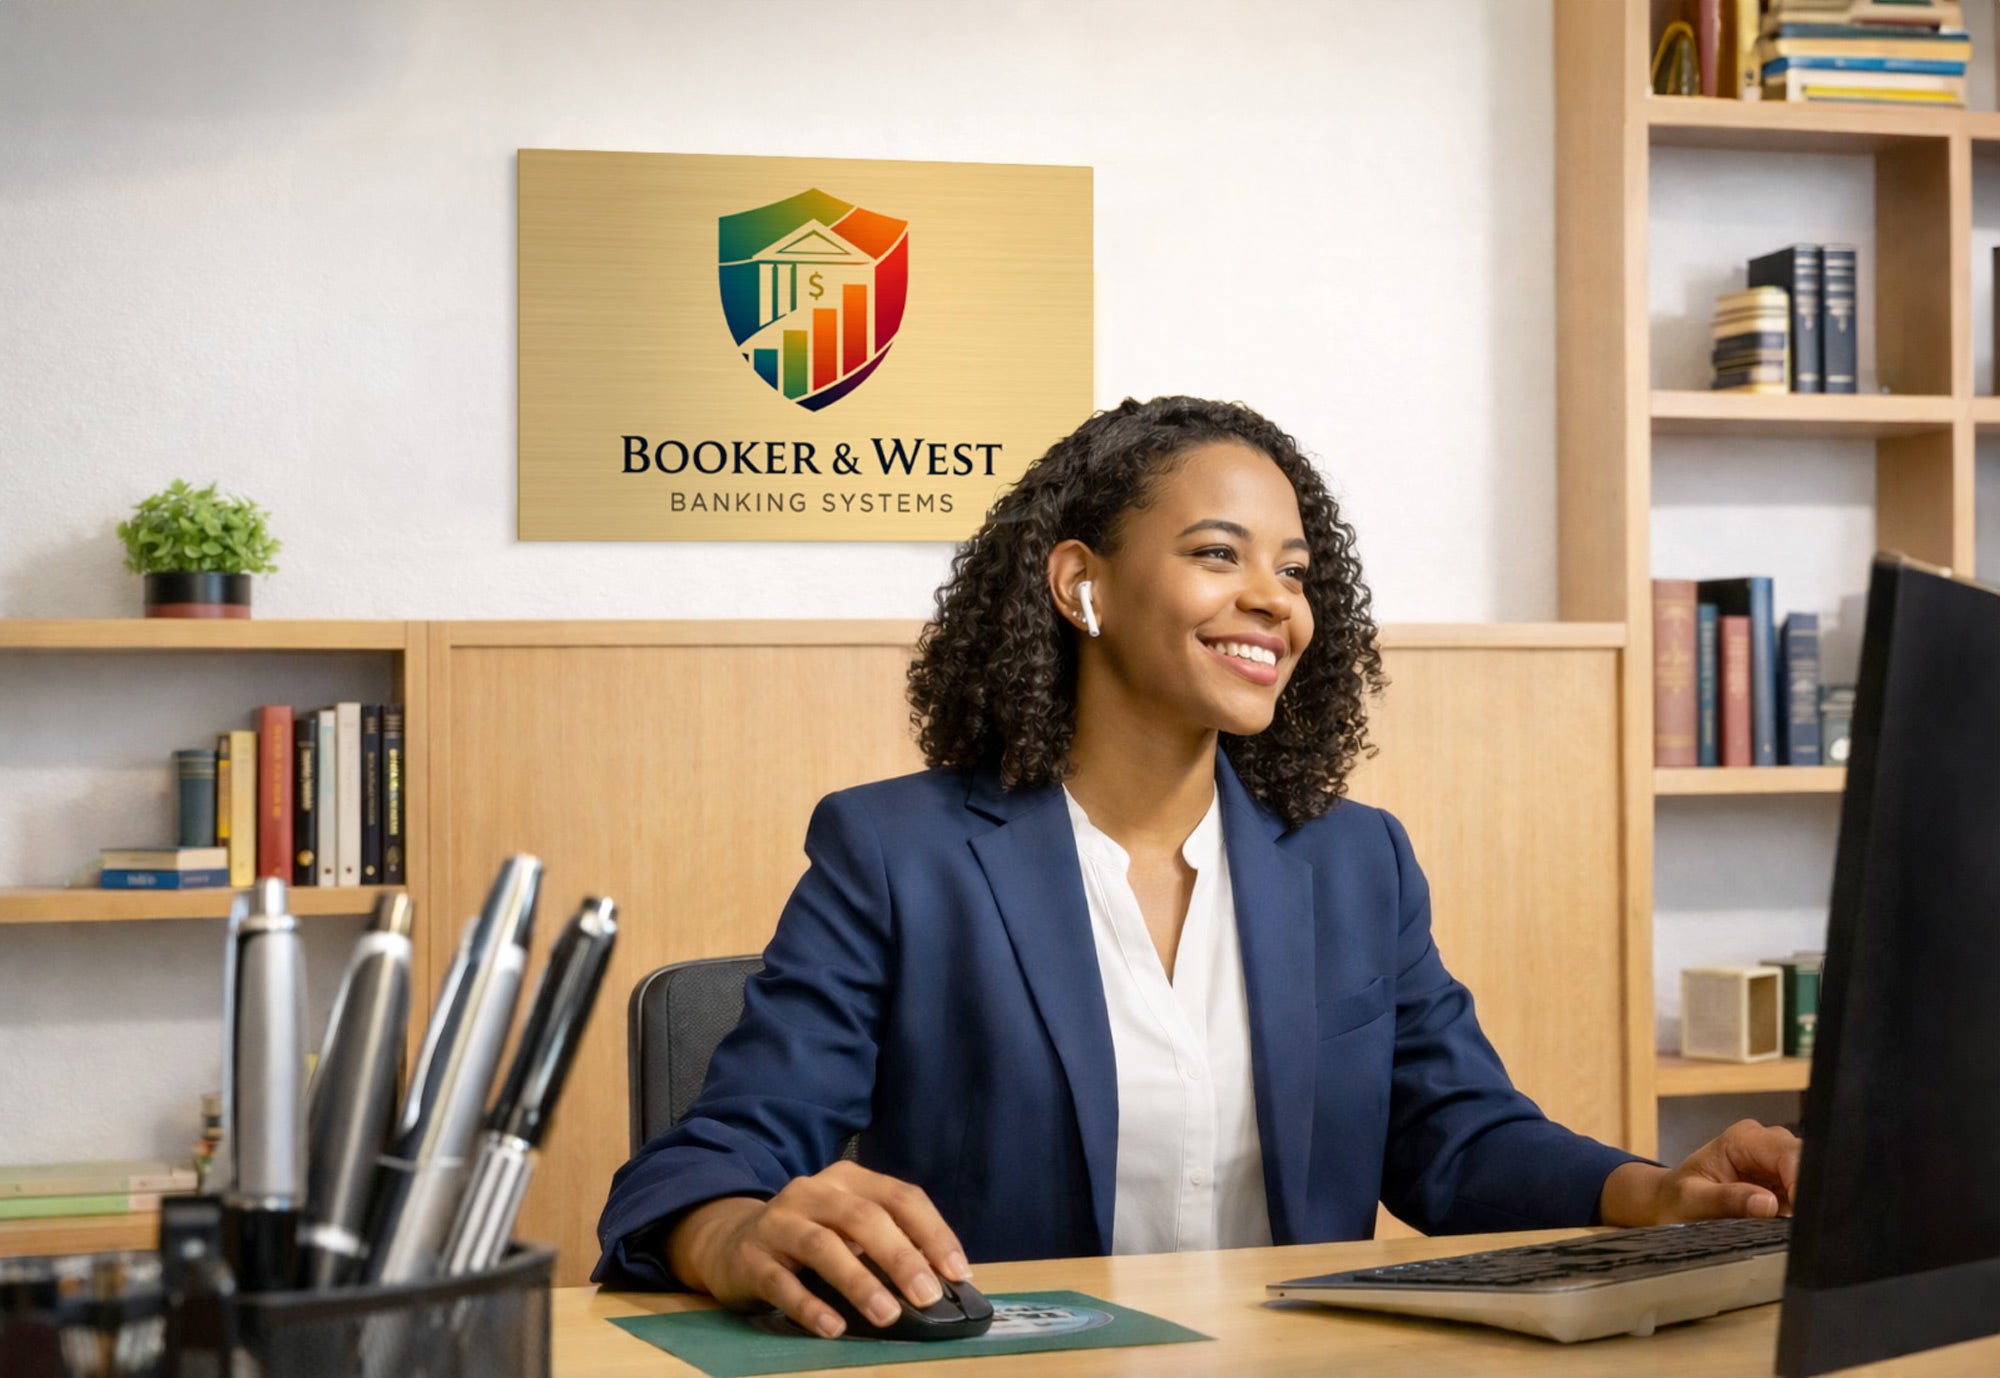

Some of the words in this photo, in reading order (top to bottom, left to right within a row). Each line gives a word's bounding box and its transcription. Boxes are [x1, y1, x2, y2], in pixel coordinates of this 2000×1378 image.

[808, 270, 825, 301] $
[620, 434, 823, 475] BOOKER
[832, 442, 863, 476] &
[870, 437, 1003, 477] WEST
[670, 491, 806, 513] BANKING
[822, 492, 954, 514] SYSTEMS
